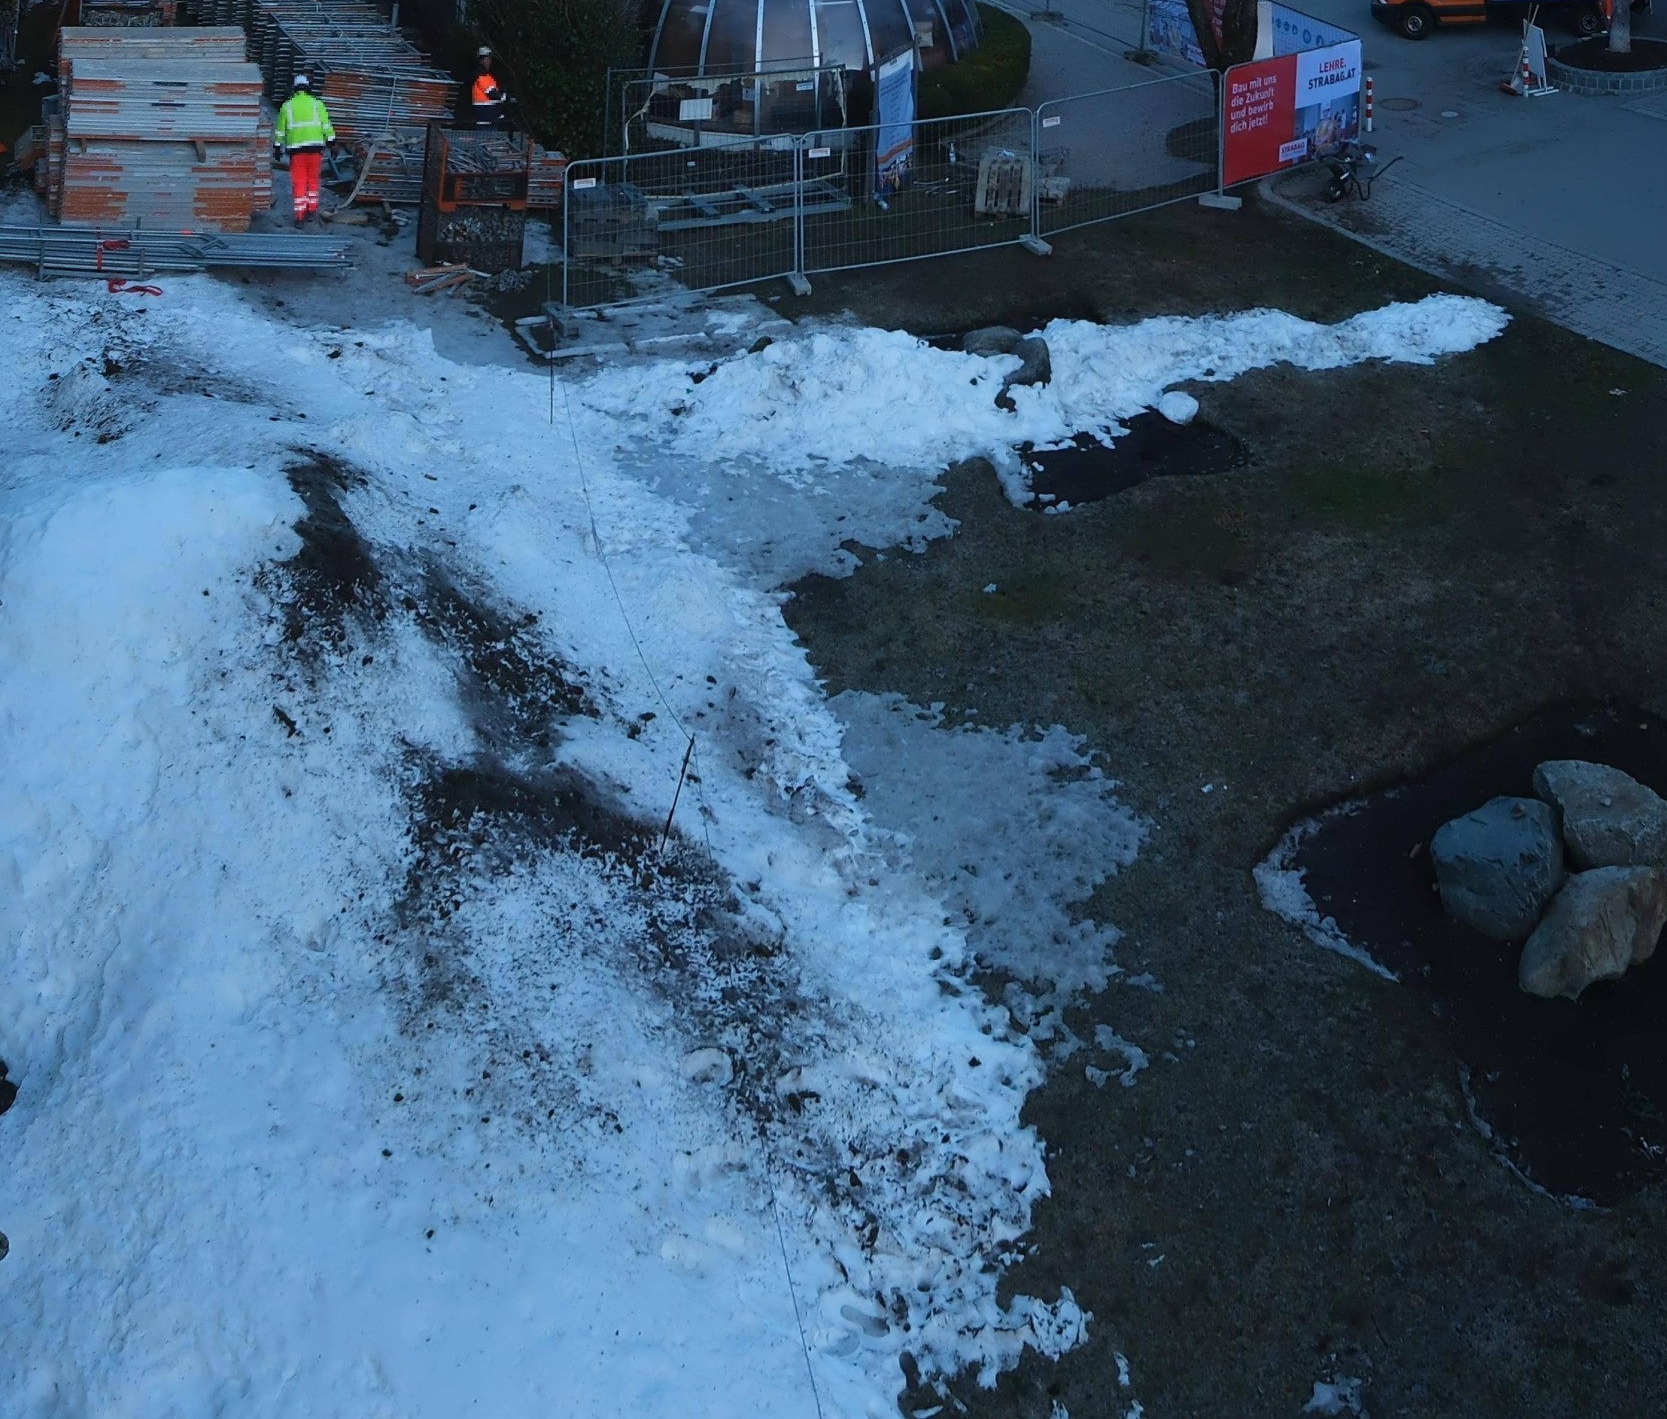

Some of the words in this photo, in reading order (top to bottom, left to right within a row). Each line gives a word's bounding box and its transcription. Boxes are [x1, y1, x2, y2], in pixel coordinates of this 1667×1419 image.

[1319, 58, 1348, 74] LEHRE.
[1232, 83, 1248, 94] Bau
[1249, 77, 1262, 90] mit
[1263, 75, 1277, 86] uns
[1308, 68, 1356, 90] STRABAG.AT
[1231, 95, 1244, 107] die
[1246, 88, 1275, 104] Zukunft
[1230, 108, 1246, 120] und
[1248, 100, 1274, 115] bewirb
[1231, 120, 1247, 133] dich
[1249, 114, 1269, 131] jetzt!
